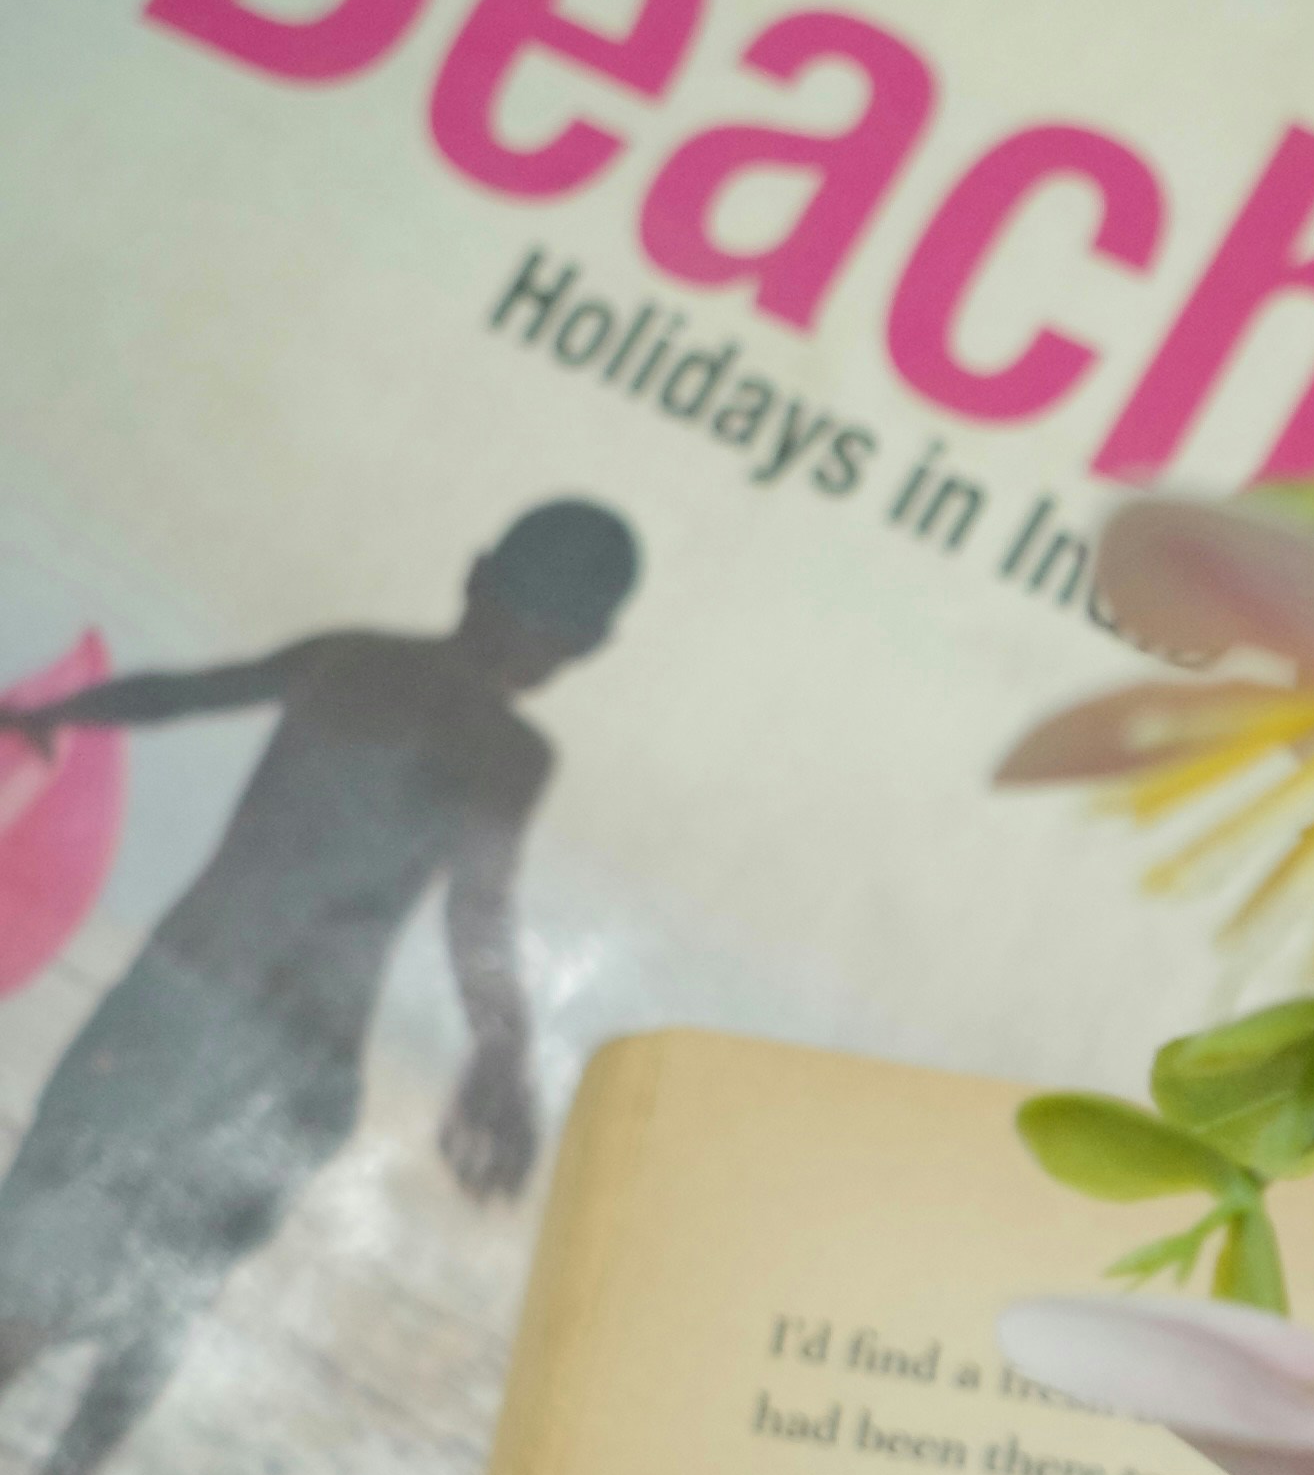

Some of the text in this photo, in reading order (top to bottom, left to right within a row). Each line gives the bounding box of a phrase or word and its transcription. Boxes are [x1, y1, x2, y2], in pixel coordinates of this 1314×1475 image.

[486, 246, 988, 555] Holidays in
[750, 1390, 842, 1446] had
[853, 1408, 967, 1469] been
